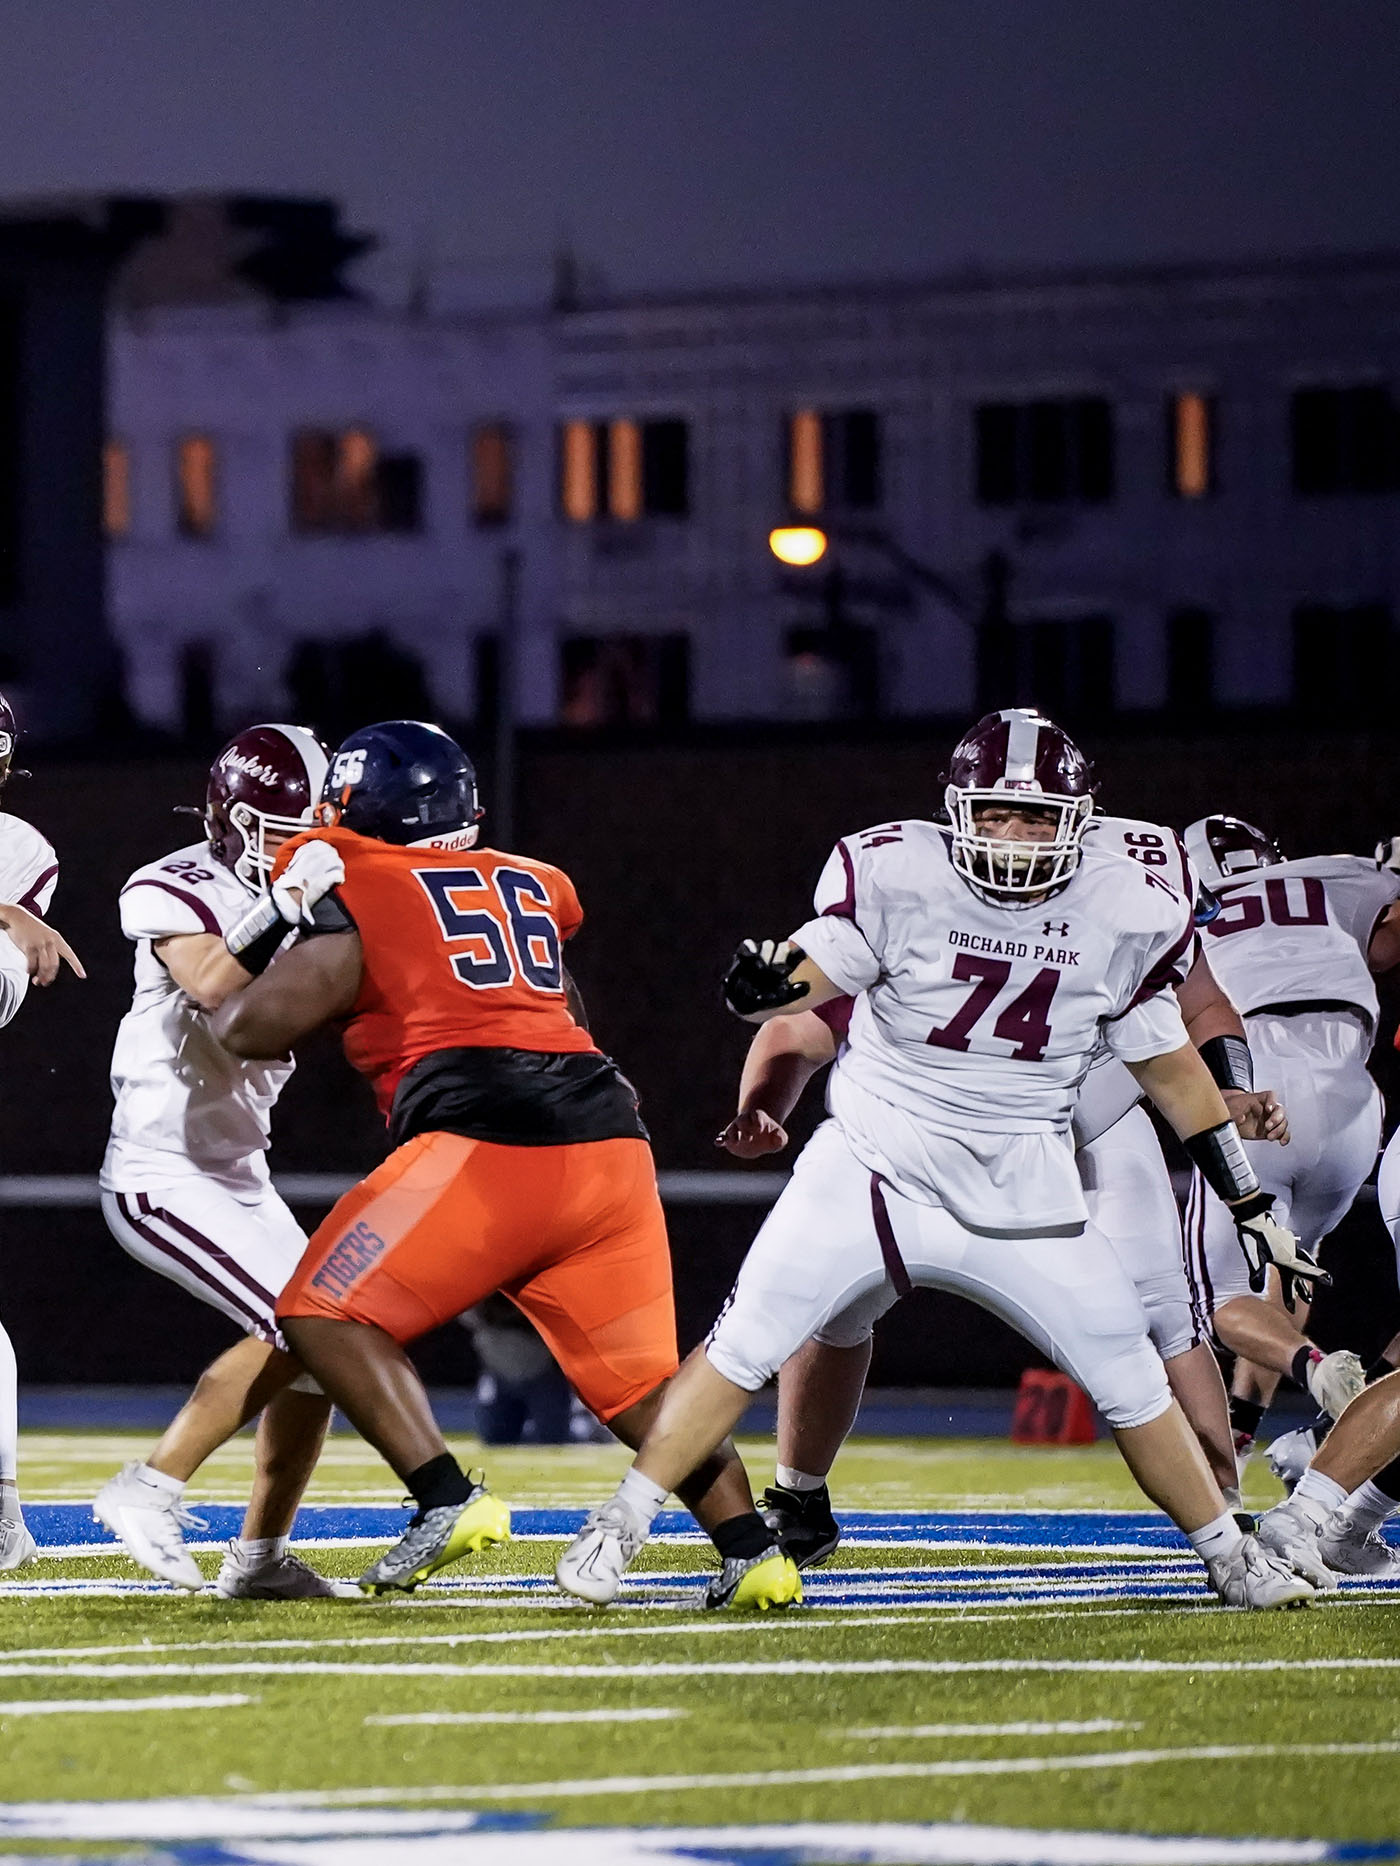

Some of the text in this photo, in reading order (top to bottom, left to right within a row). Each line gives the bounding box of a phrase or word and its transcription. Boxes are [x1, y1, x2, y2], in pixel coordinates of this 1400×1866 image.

[218, 745, 280, 787] Quakers
[330, 748, 368, 789] 56
[160, 860, 215, 886] 22
[411, 867, 564, 994] 56
[948, 930, 1081, 966] ORCHARD PARK
[926, 952, 1062, 1062] 74
[311, 1221, 385, 1299] TIGERS
